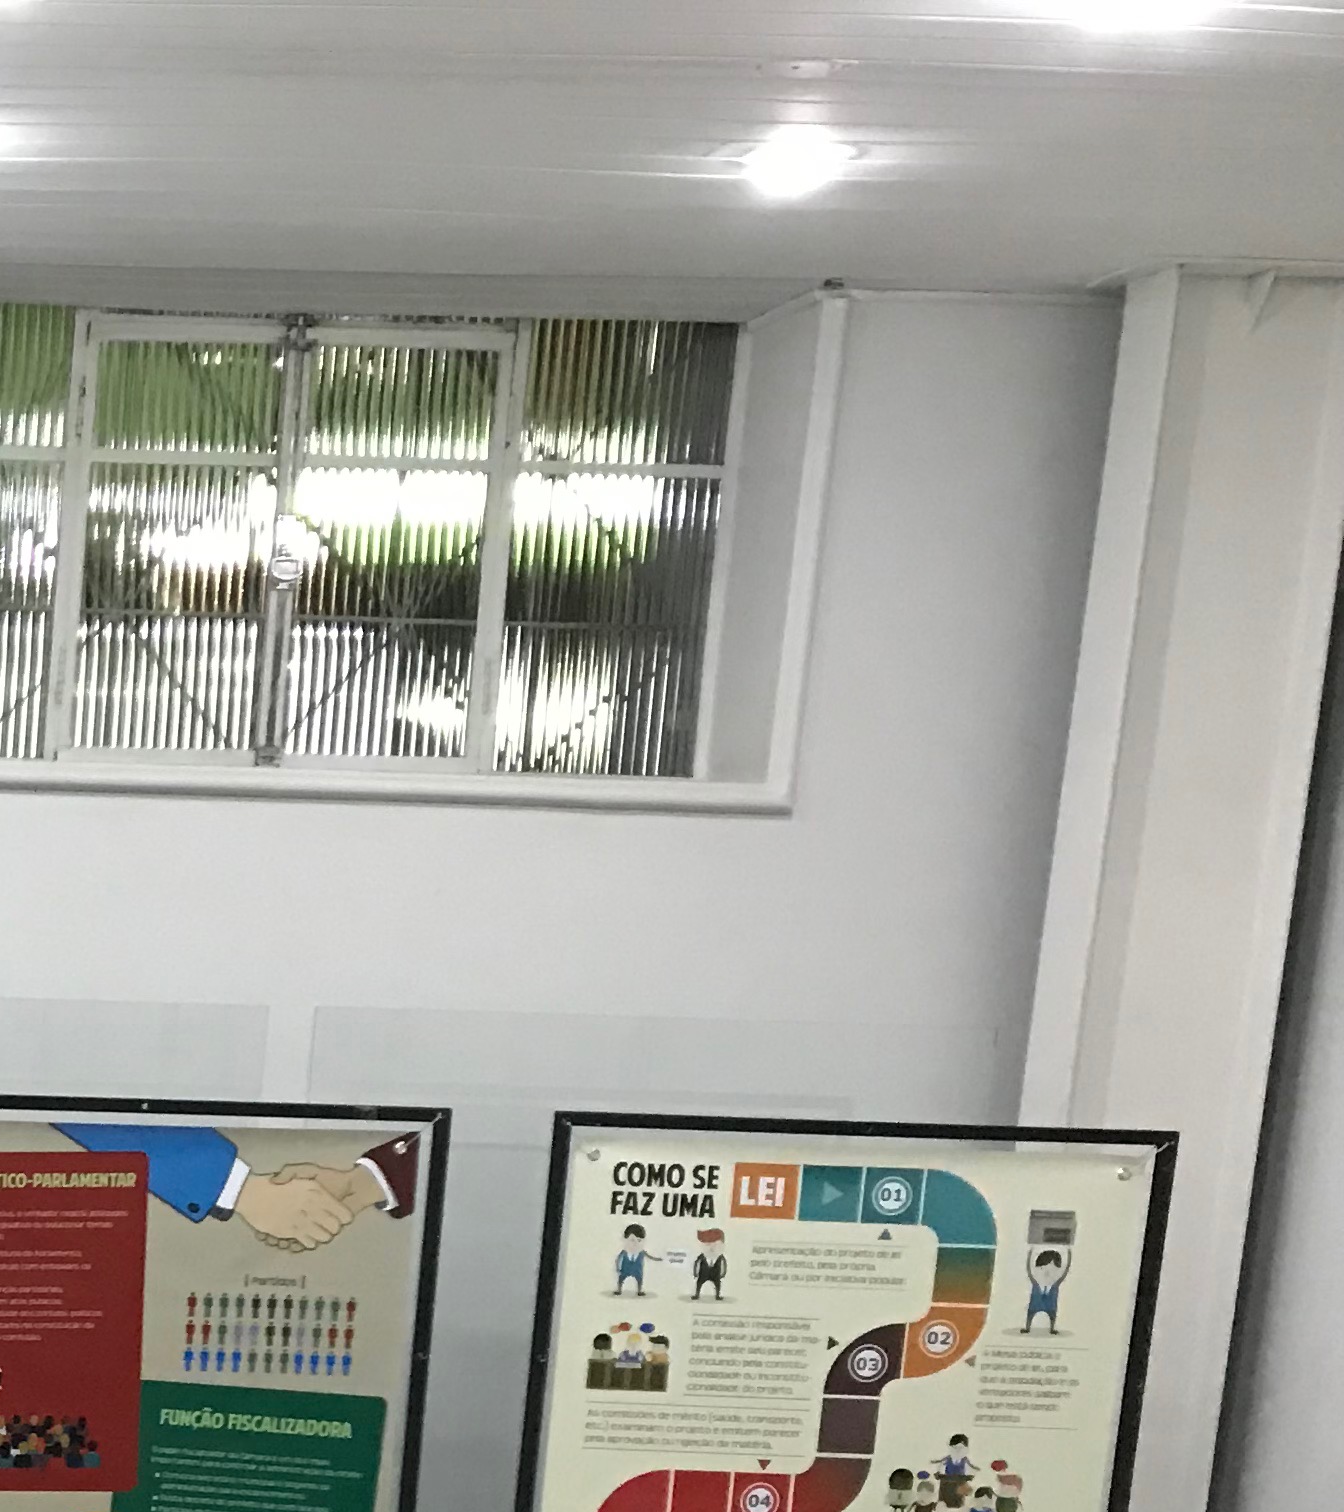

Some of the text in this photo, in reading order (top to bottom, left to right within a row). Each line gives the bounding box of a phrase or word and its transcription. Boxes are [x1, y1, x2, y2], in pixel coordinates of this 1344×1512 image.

[613, 1161, 721, 1190] COMO SE
[739, 1175, 786, 1207] LEI
[880, 1187, 903, 1202] 01
[610, 1190, 716, 1219] FAZ UMA
[926, 1331, 951, 1346] 02
[855, 1356, 880, 1372] 03
[159, 1407, 353, 1439] FUNÇÃO FISCALIZADORA
[748, 1494, 772, 1508] 04
